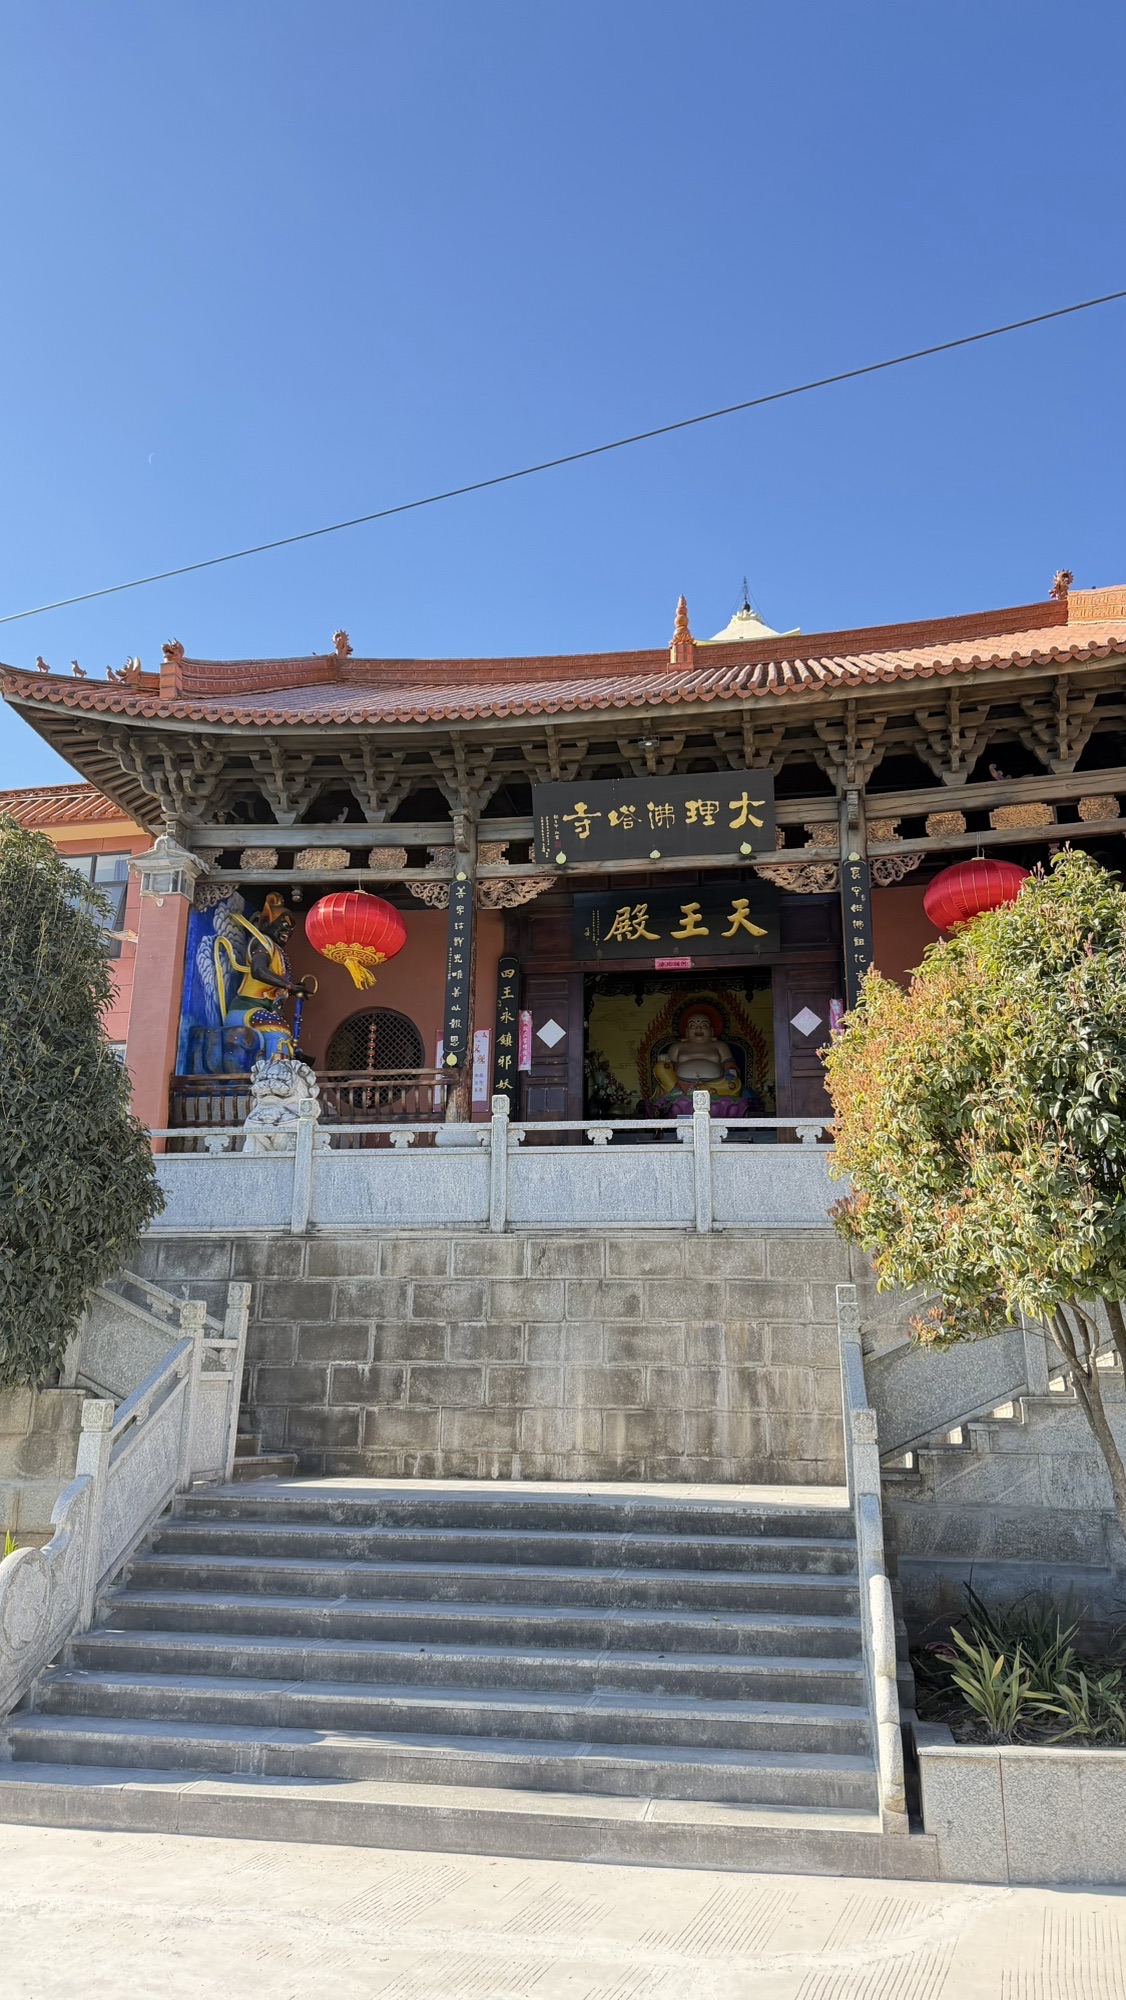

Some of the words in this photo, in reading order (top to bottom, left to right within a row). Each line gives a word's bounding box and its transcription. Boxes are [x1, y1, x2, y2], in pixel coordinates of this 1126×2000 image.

[562, 791, 766, 839] 大理佛塔寺
[603, 898, 769, 942] 天王殿
